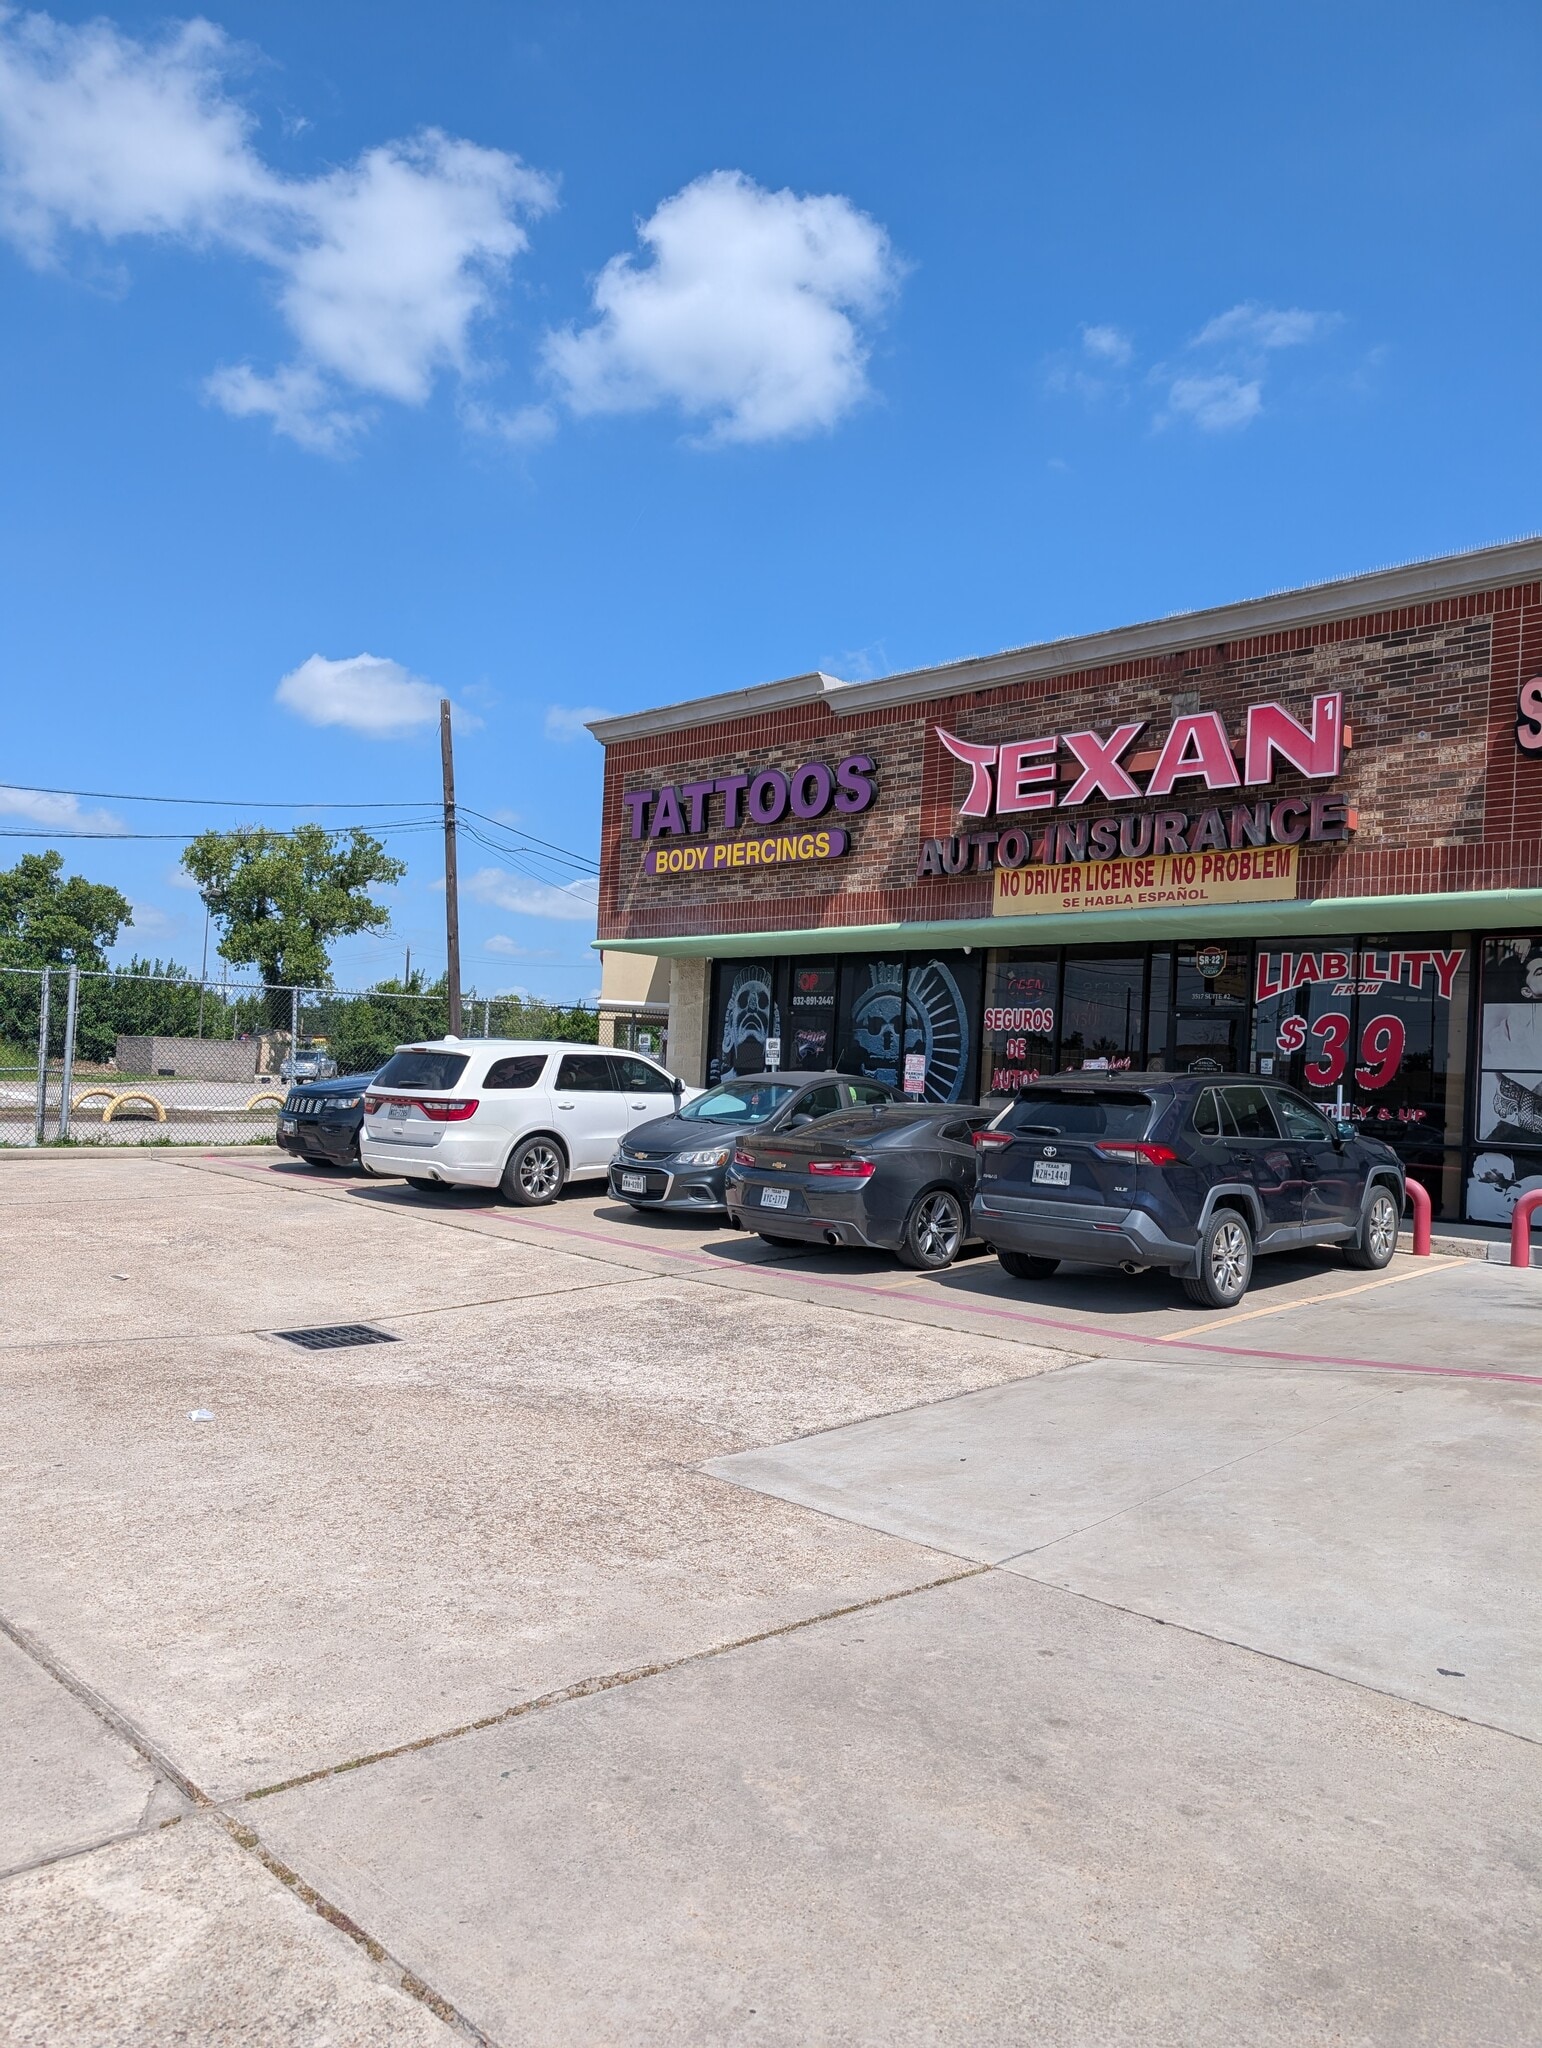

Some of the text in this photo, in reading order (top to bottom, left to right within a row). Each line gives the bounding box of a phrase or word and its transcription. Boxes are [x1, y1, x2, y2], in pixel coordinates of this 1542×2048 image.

[935, 691, 1342, 817] TEXAN
[624, 754, 876, 840] TATTOOS
[656, 832, 830, 873] BODY PIERCINGS
[917, 793, 1348, 876] AUTO INSURANCE
[1000, 849, 1291, 897] NO DRIVER LICENSE / NO PROBLEM
[1062, 886, 1209, 908] SE HABLA ESPAÑOL
[1255, 949, 1466, 1004] LIABILITY
[1332, 981, 1382, 996] FROM
[984, 1007, 1053, 1031] SEGUROS
[1006, 1037, 1027, 1059] DE
[1377, 1106, 1395, 1120] &
[1399, 1107, 1426, 1123] UP
